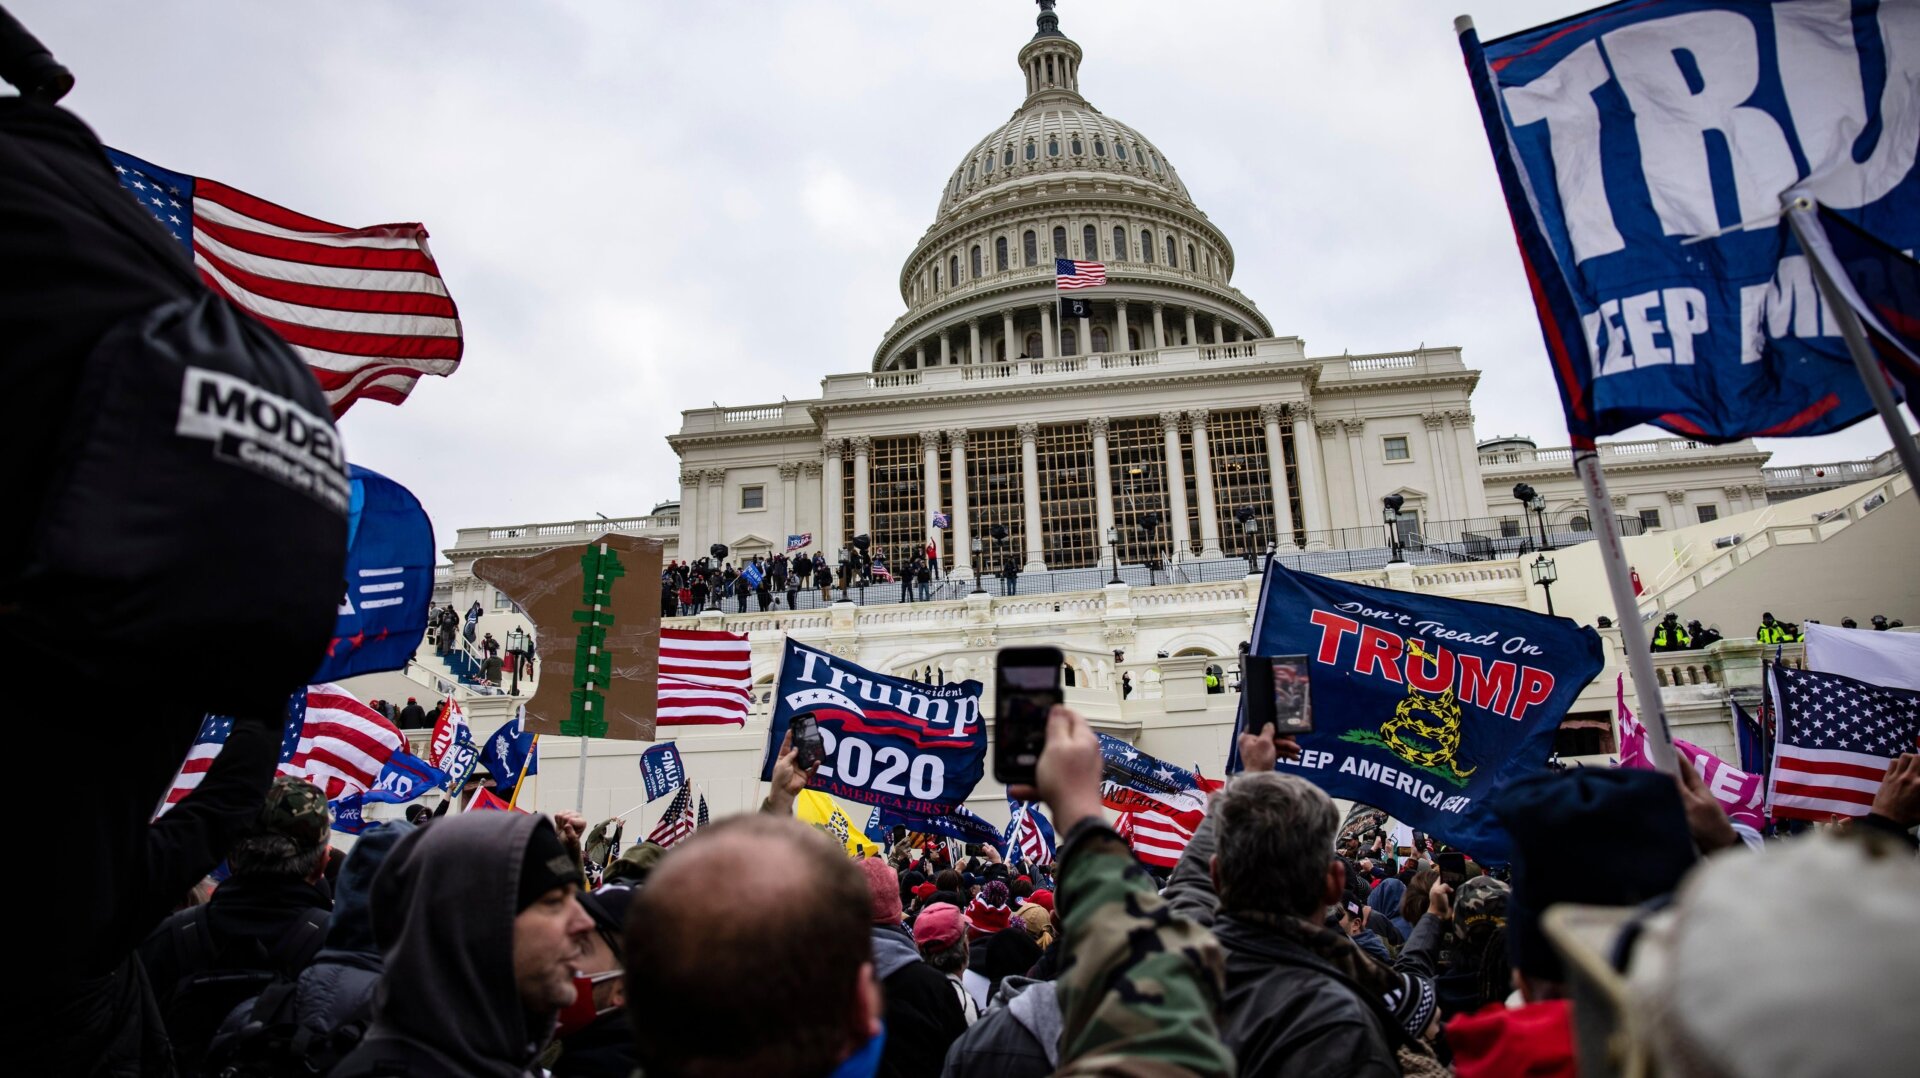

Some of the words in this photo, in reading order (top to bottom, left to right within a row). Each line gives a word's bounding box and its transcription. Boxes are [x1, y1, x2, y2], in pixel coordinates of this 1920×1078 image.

[1333, 602, 1411, 626] Don't
[1415, 620, 1498, 646] Tread
[1501, 635, 1544, 656] On
[794, 646, 979, 738] Trump
[1310, 608, 1555, 721] TRUMP
[817, 727, 945, 801] 2020
[1339, 756, 1444, 809] AMERICA
[829, 780, 902, 807] AMERICA
[905, 799, 952, 815] FIRST
